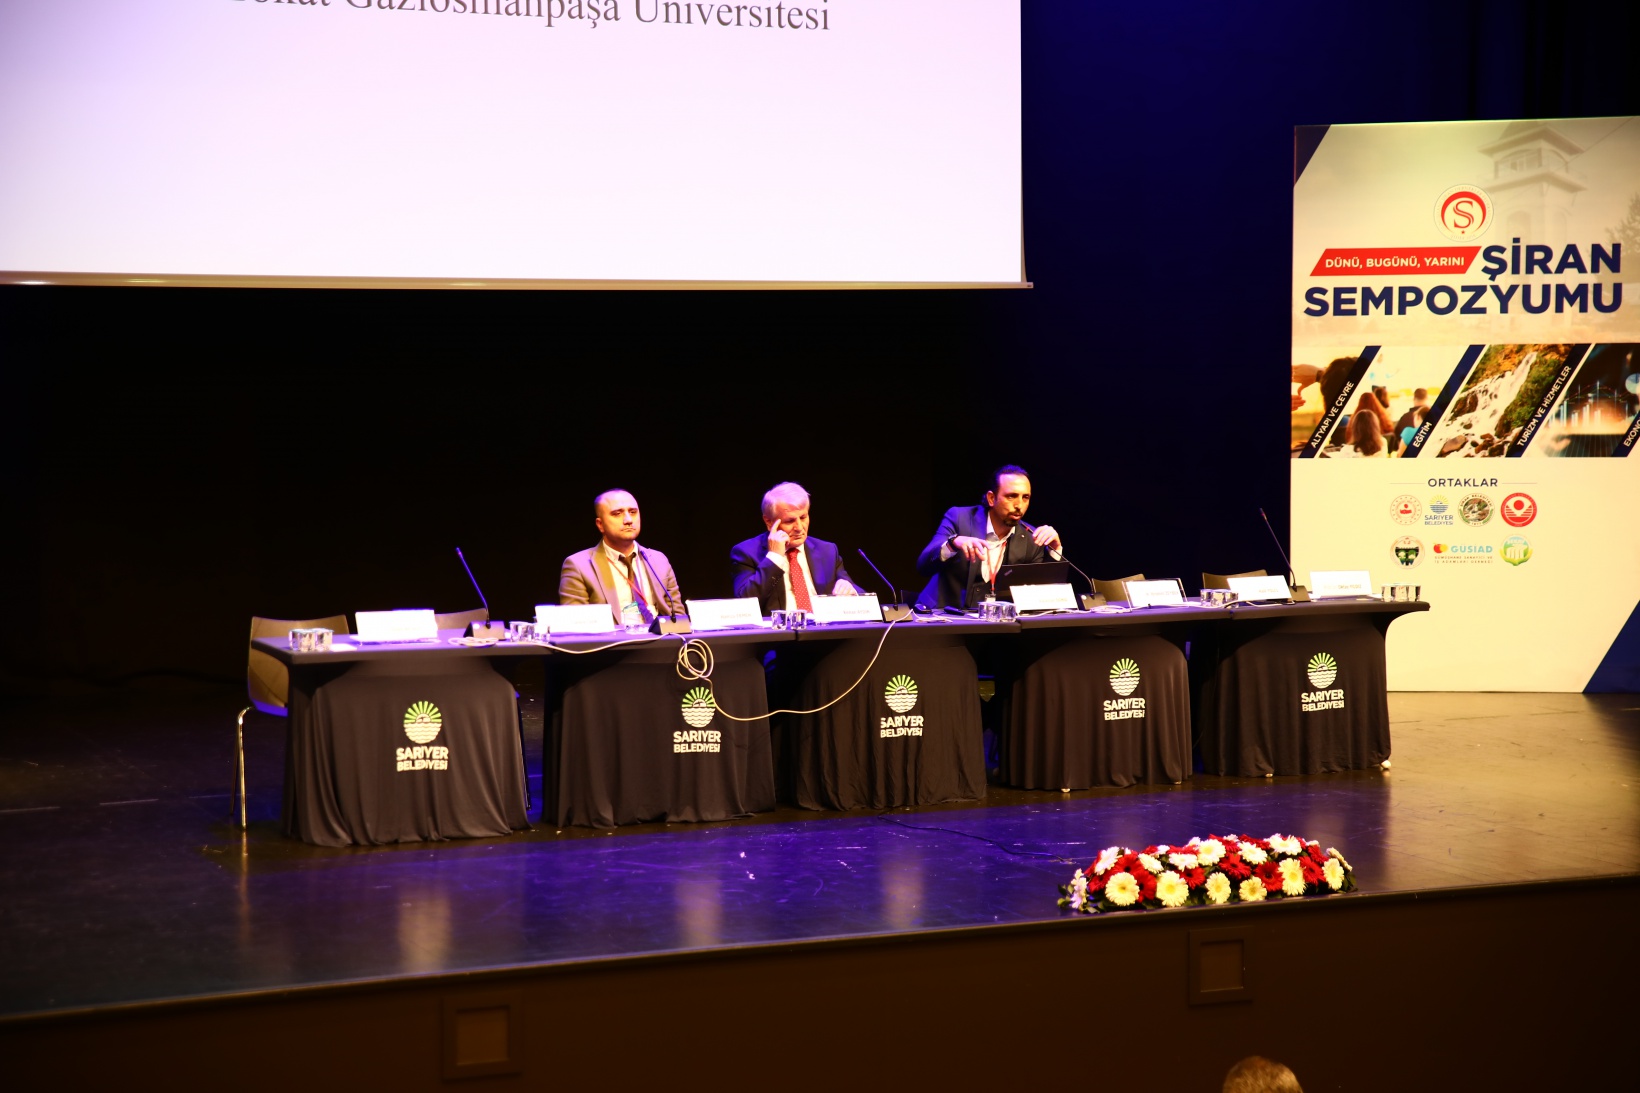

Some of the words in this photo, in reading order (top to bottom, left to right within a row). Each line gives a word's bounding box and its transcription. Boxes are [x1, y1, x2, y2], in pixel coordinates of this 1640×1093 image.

[1325, 256, 1363, 270] DÜNÜ,
[1366, 255, 1421, 269] BUGÜNÜ,
[1424, 256, 1465, 267] YARINI
[1481, 237, 1622, 282] ŞİRAN
[1303, 282, 1623, 317] SEMPOZYUMU
[1516, 418, 1539, 446] TURİZM
[1534, 406, 1546, 418] VE
[1541, 365, 1572, 408] HİZMETLER
[1310, 417, 1333, 449] ALTYAPI
[1328, 406, 1339, 417] VE
[1412, 421, 1433, 448] EĞİTİM
[1427, 477, 1498, 487] ORTAKLAR
[1301, 689, 1344, 702] SARIYER
[1103, 698, 1145, 711] SARIYER
[880, 715, 924, 728] SARIYER
[673, 730, 721, 743] SARIYER
[396, 746, 449, 761] SARIYER
